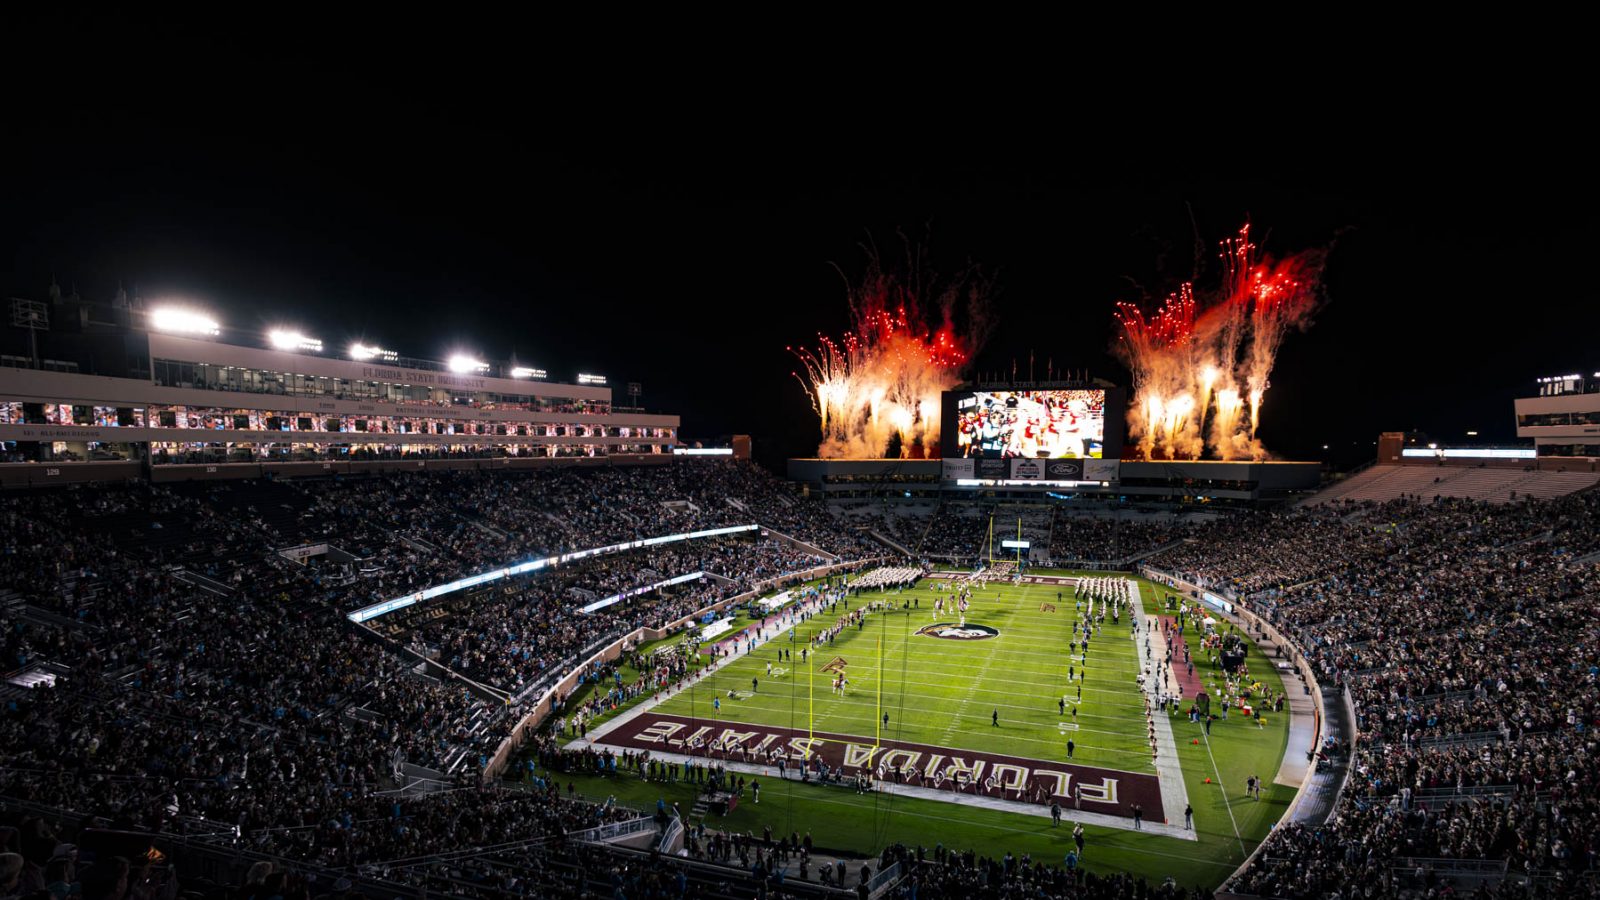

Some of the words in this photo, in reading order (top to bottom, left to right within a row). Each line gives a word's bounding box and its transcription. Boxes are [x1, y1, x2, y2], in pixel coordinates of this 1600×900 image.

[363, 367, 402, 380] FLORIDA
[406, 372, 435, 384] STATE
[633, 721, 825, 759] STATE
[843, 743, 1119, 804] FLORIDA
